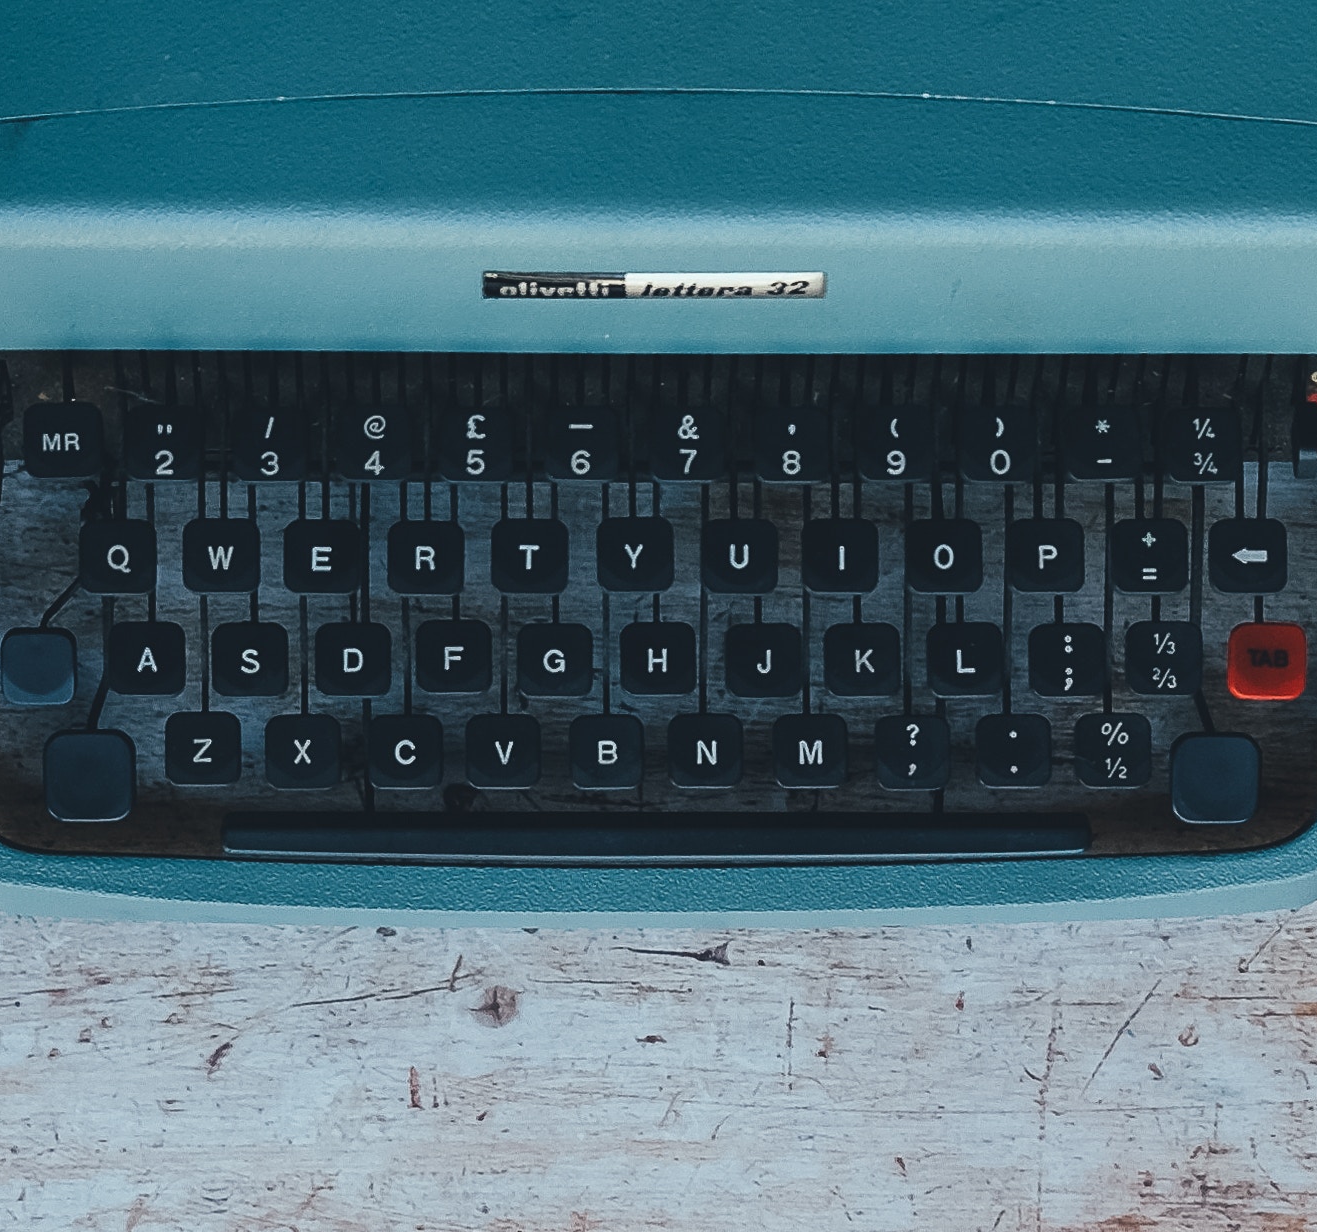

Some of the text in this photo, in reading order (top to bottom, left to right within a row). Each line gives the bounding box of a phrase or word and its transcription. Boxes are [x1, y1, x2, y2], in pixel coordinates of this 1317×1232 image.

[499, 281, 610, 297] olivetti
[640, 280, 810, 297] lettera 32
[265, 416, 275, 439] /
[363, 415, 386, 440] @
[466, 414, 486, 440] £
[677, 414, 700, 440] &
[890, 418, 899, 438] (
[995, 417, 1005, 437] )
[42, 432, 80, 451] MR
[154, 450, 174, 475] 2
[260, 451, 280, 476] 3
[364, 450, 385, 476] 4
[466, 449, 485, 475] 5
[570, 449, 591, 475] 6
[679, 448, 698, 474] 7
[782, 450, 801, 475] 8
[886, 450, 906, 475] 9
[990, 449, 1011, 475] 0
[107, 544, 132, 573] Q
[208, 545, 234, 570] W
[311, 546, 333, 572] E
[415, 545, 436, 571] R
[519, 544, 540, 570] T
[624, 543, 644, 569] Y
[729, 543, 749, 570] U
[838, 545, 845, 571] I
[933, 543, 954, 570] O
[1038, 544, 1058, 570] P
[1142, 567, 1157, 580] =
[137, 646, 158, 673] A
[240, 648, 260, 674] S
[343, 647, 364, 673] D
[444, 646, 464, 671] F
[543, 649, 566, 673] G
[647, 648, 668, 673] H
[756, 649, 772, 674] J
[854, 649, 875, 673] K
[956, 649, 976, 674] L
[1247, 648, 1290, 668] TAB
[906, 723, 920, 747] ?
[1101, 721, 1129, 746] %
[192, 738, 213, 763] Z
[293, 739, 311, 765] X
[394, 739, 417, 765] C
[494, 741, 514, 765] V
[597, 740, 618, 765] B
[696, 740, 717, 766] N
[798, 740, 823, 765] M
